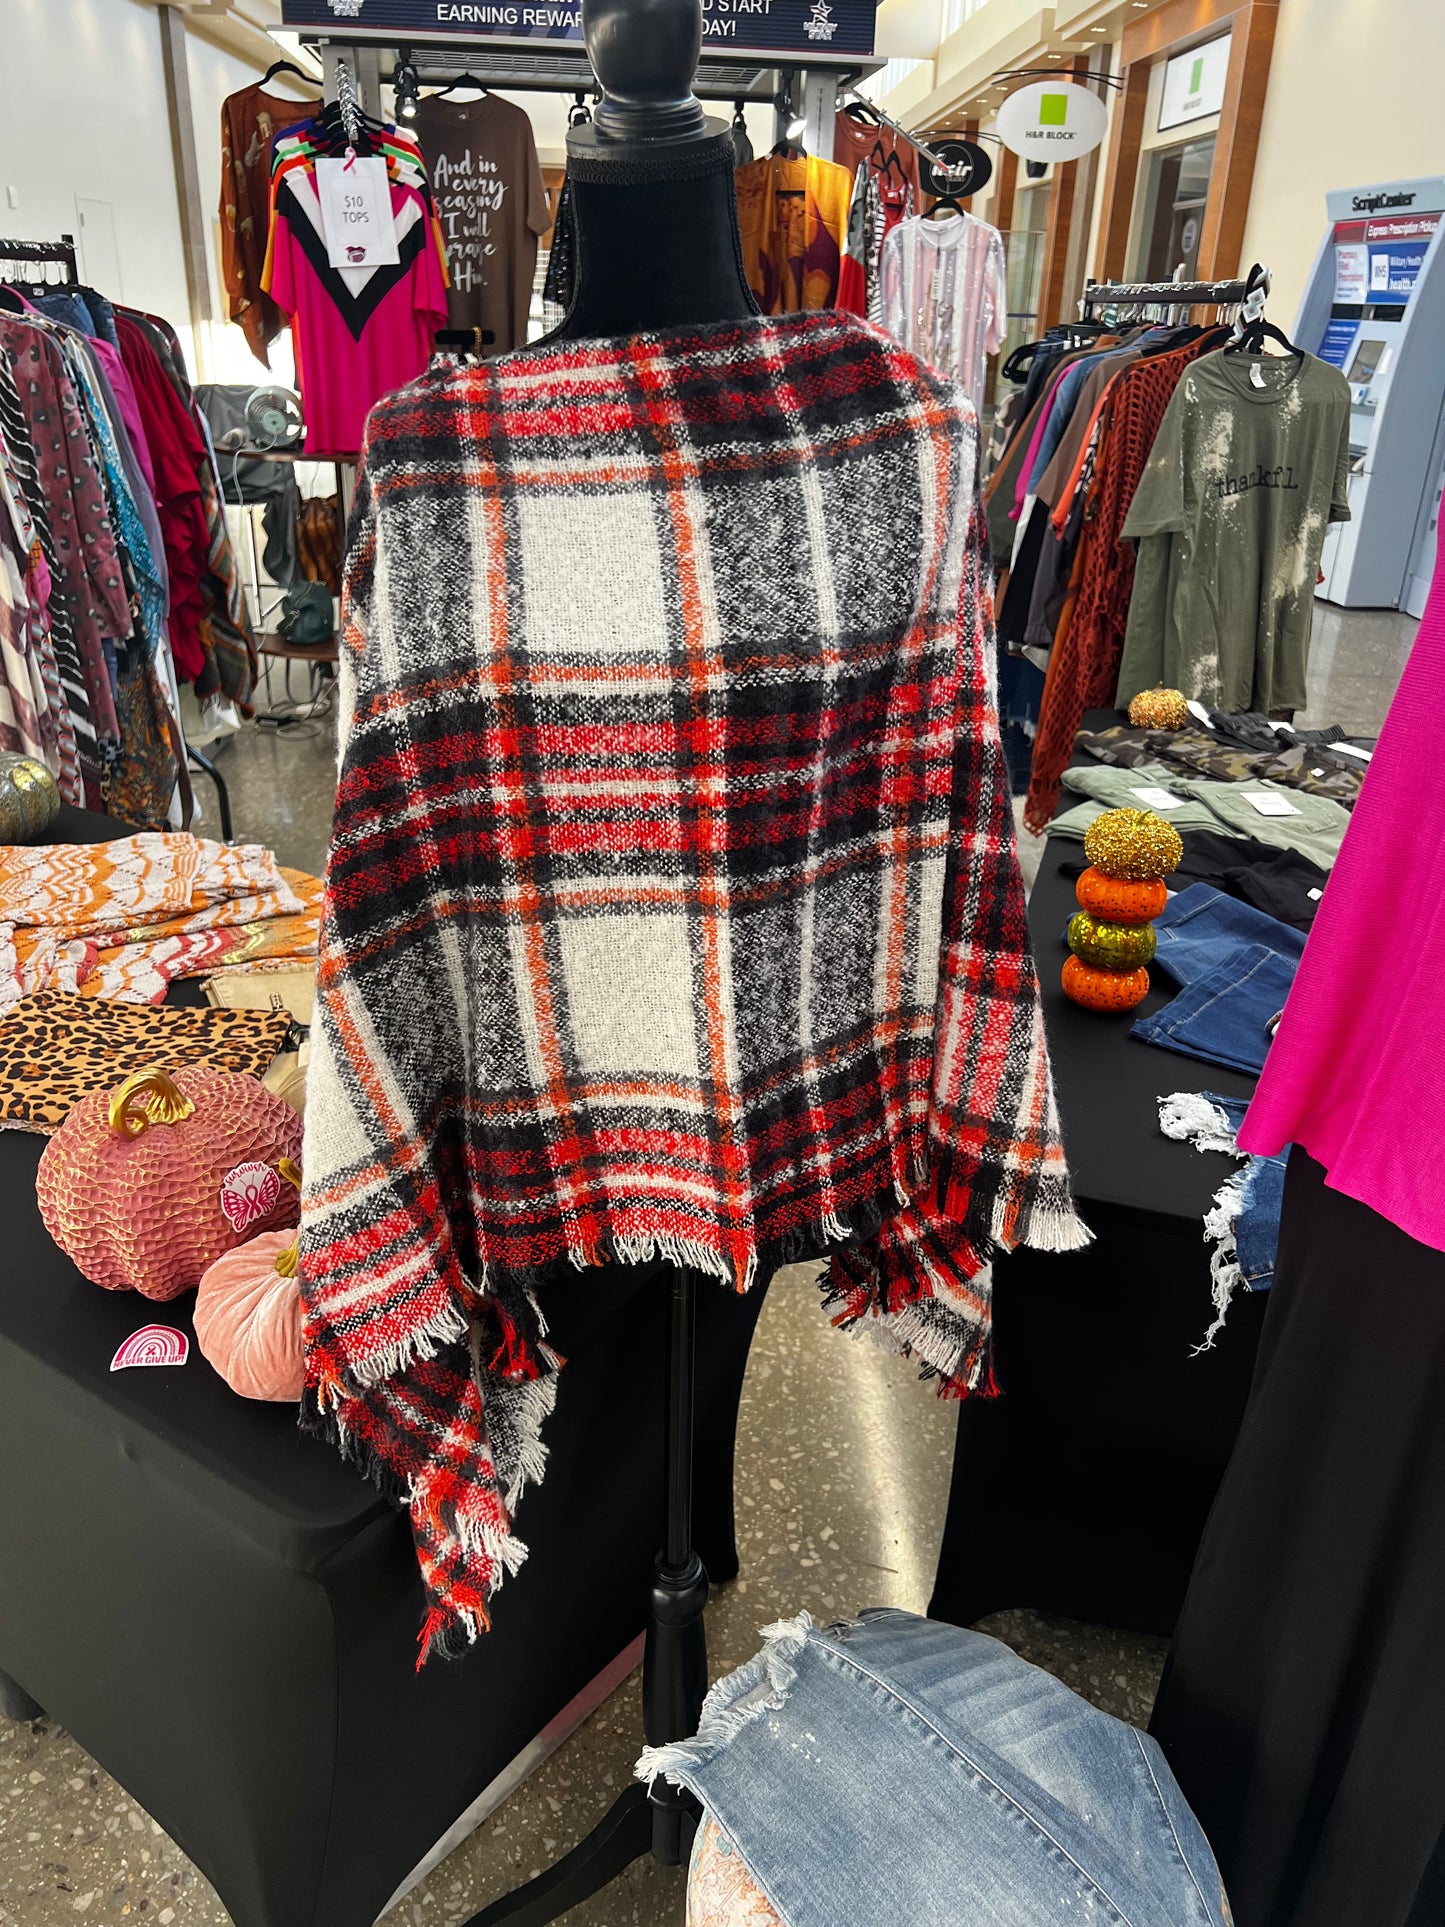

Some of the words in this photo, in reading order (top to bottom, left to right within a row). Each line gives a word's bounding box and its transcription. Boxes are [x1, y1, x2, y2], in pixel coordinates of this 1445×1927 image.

[437, 4, 518, 24] EARNING
[718, 0, 772, 14] START
[1025, 130, 1044, 139] H&R
[1046, 131, 1074, 140] BLOCK
[433, 148, 476, 189] And
[478, 155, 498, 173] in
[452, 177, 508, 211] every
[341, 211, 370, 223] TOPS
[443, 212, 460, 239] I
[225, 1162, 268, 1186] survivor
[113, 1357, 143, 1368] NEVER
[145, 1355, 167, 1364] GIVE
[168, 1355, 184, 1363] UP!
